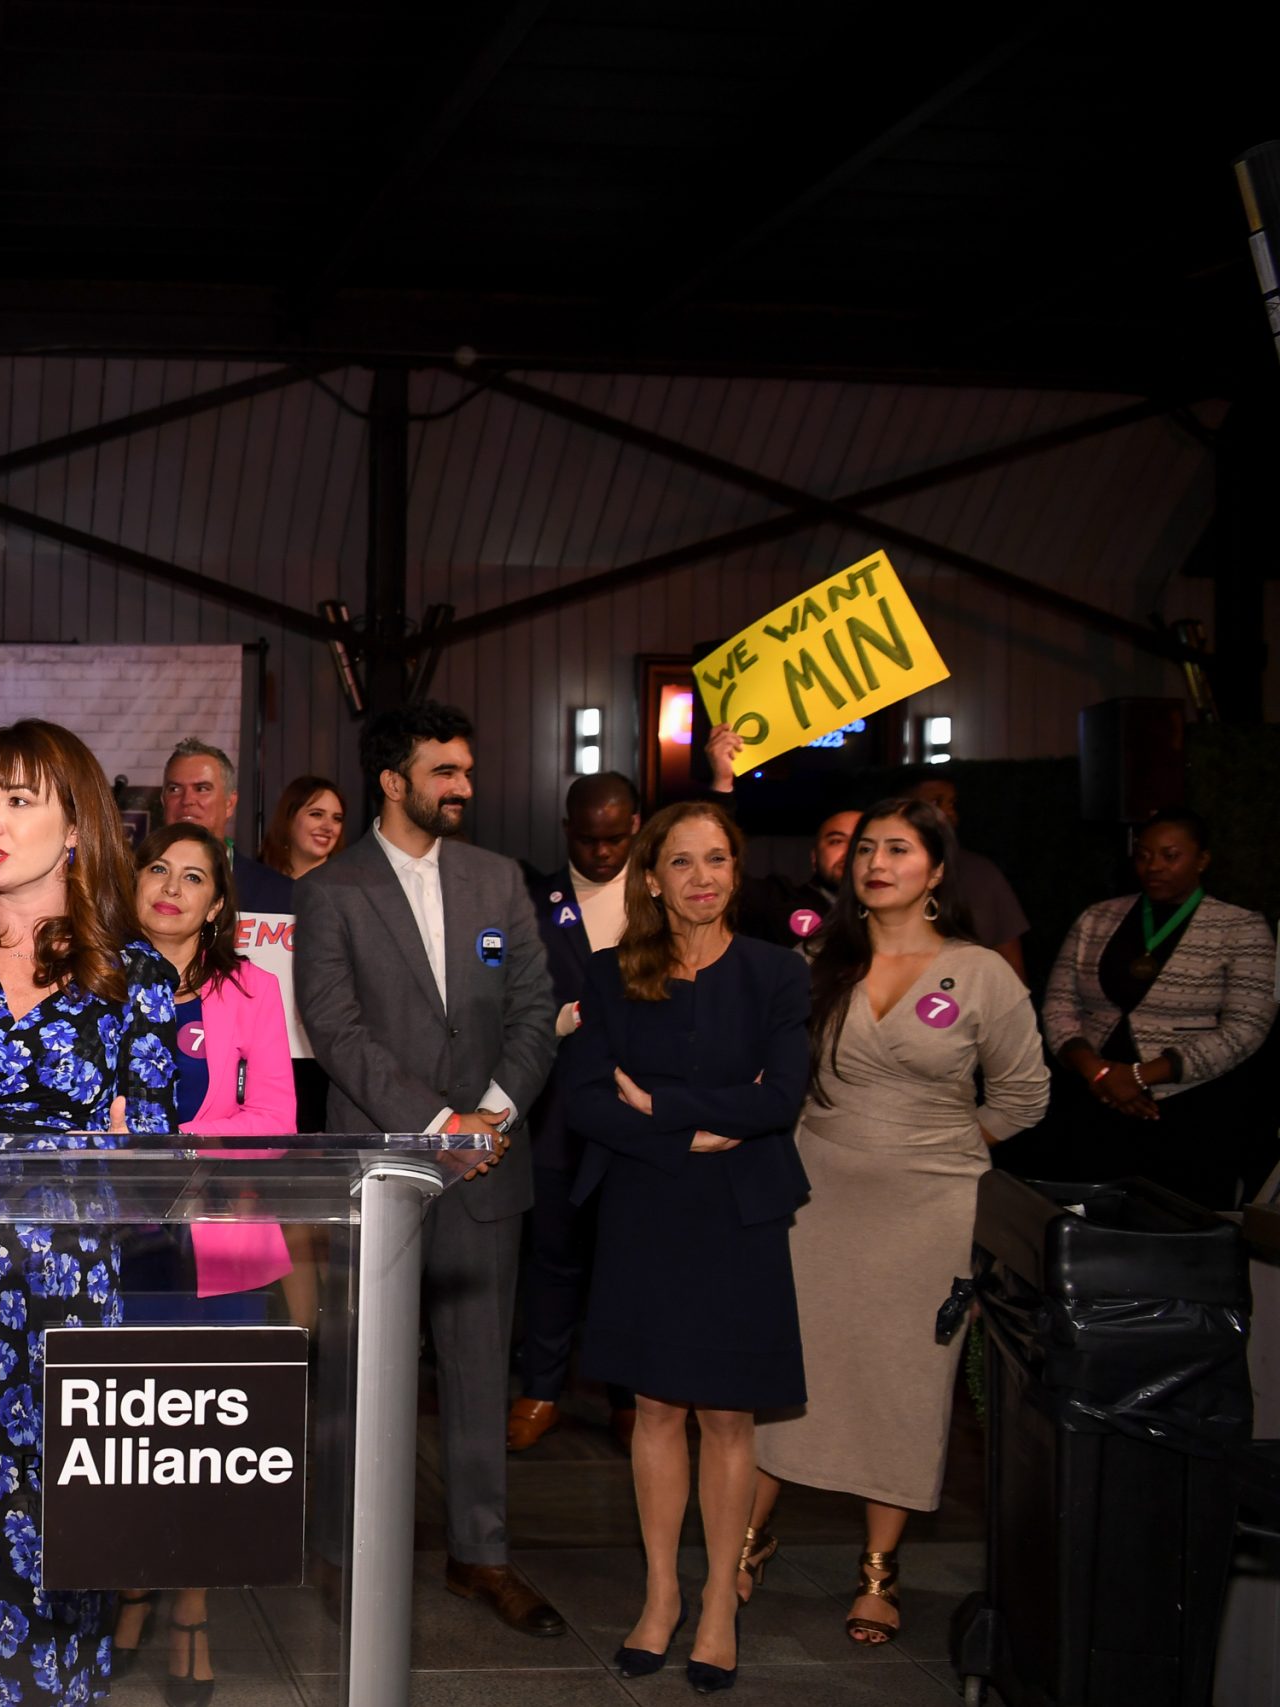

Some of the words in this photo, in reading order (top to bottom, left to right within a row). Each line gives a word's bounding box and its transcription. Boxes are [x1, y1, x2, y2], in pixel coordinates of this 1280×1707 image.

[702, 639, 759, 690] WE
[762, 560, 881, 643] WANT
[783, 596, 914, 730] MIN
[559, 906, 577, 924] A
[797, 915, 813, 933] 7
[927, 997, 951, 1019] 7
[190, 1028, 205, 1051] 7
[61, 1378, 249, 1427] Riders
[57, 1437, 293, 1485] Alliance
